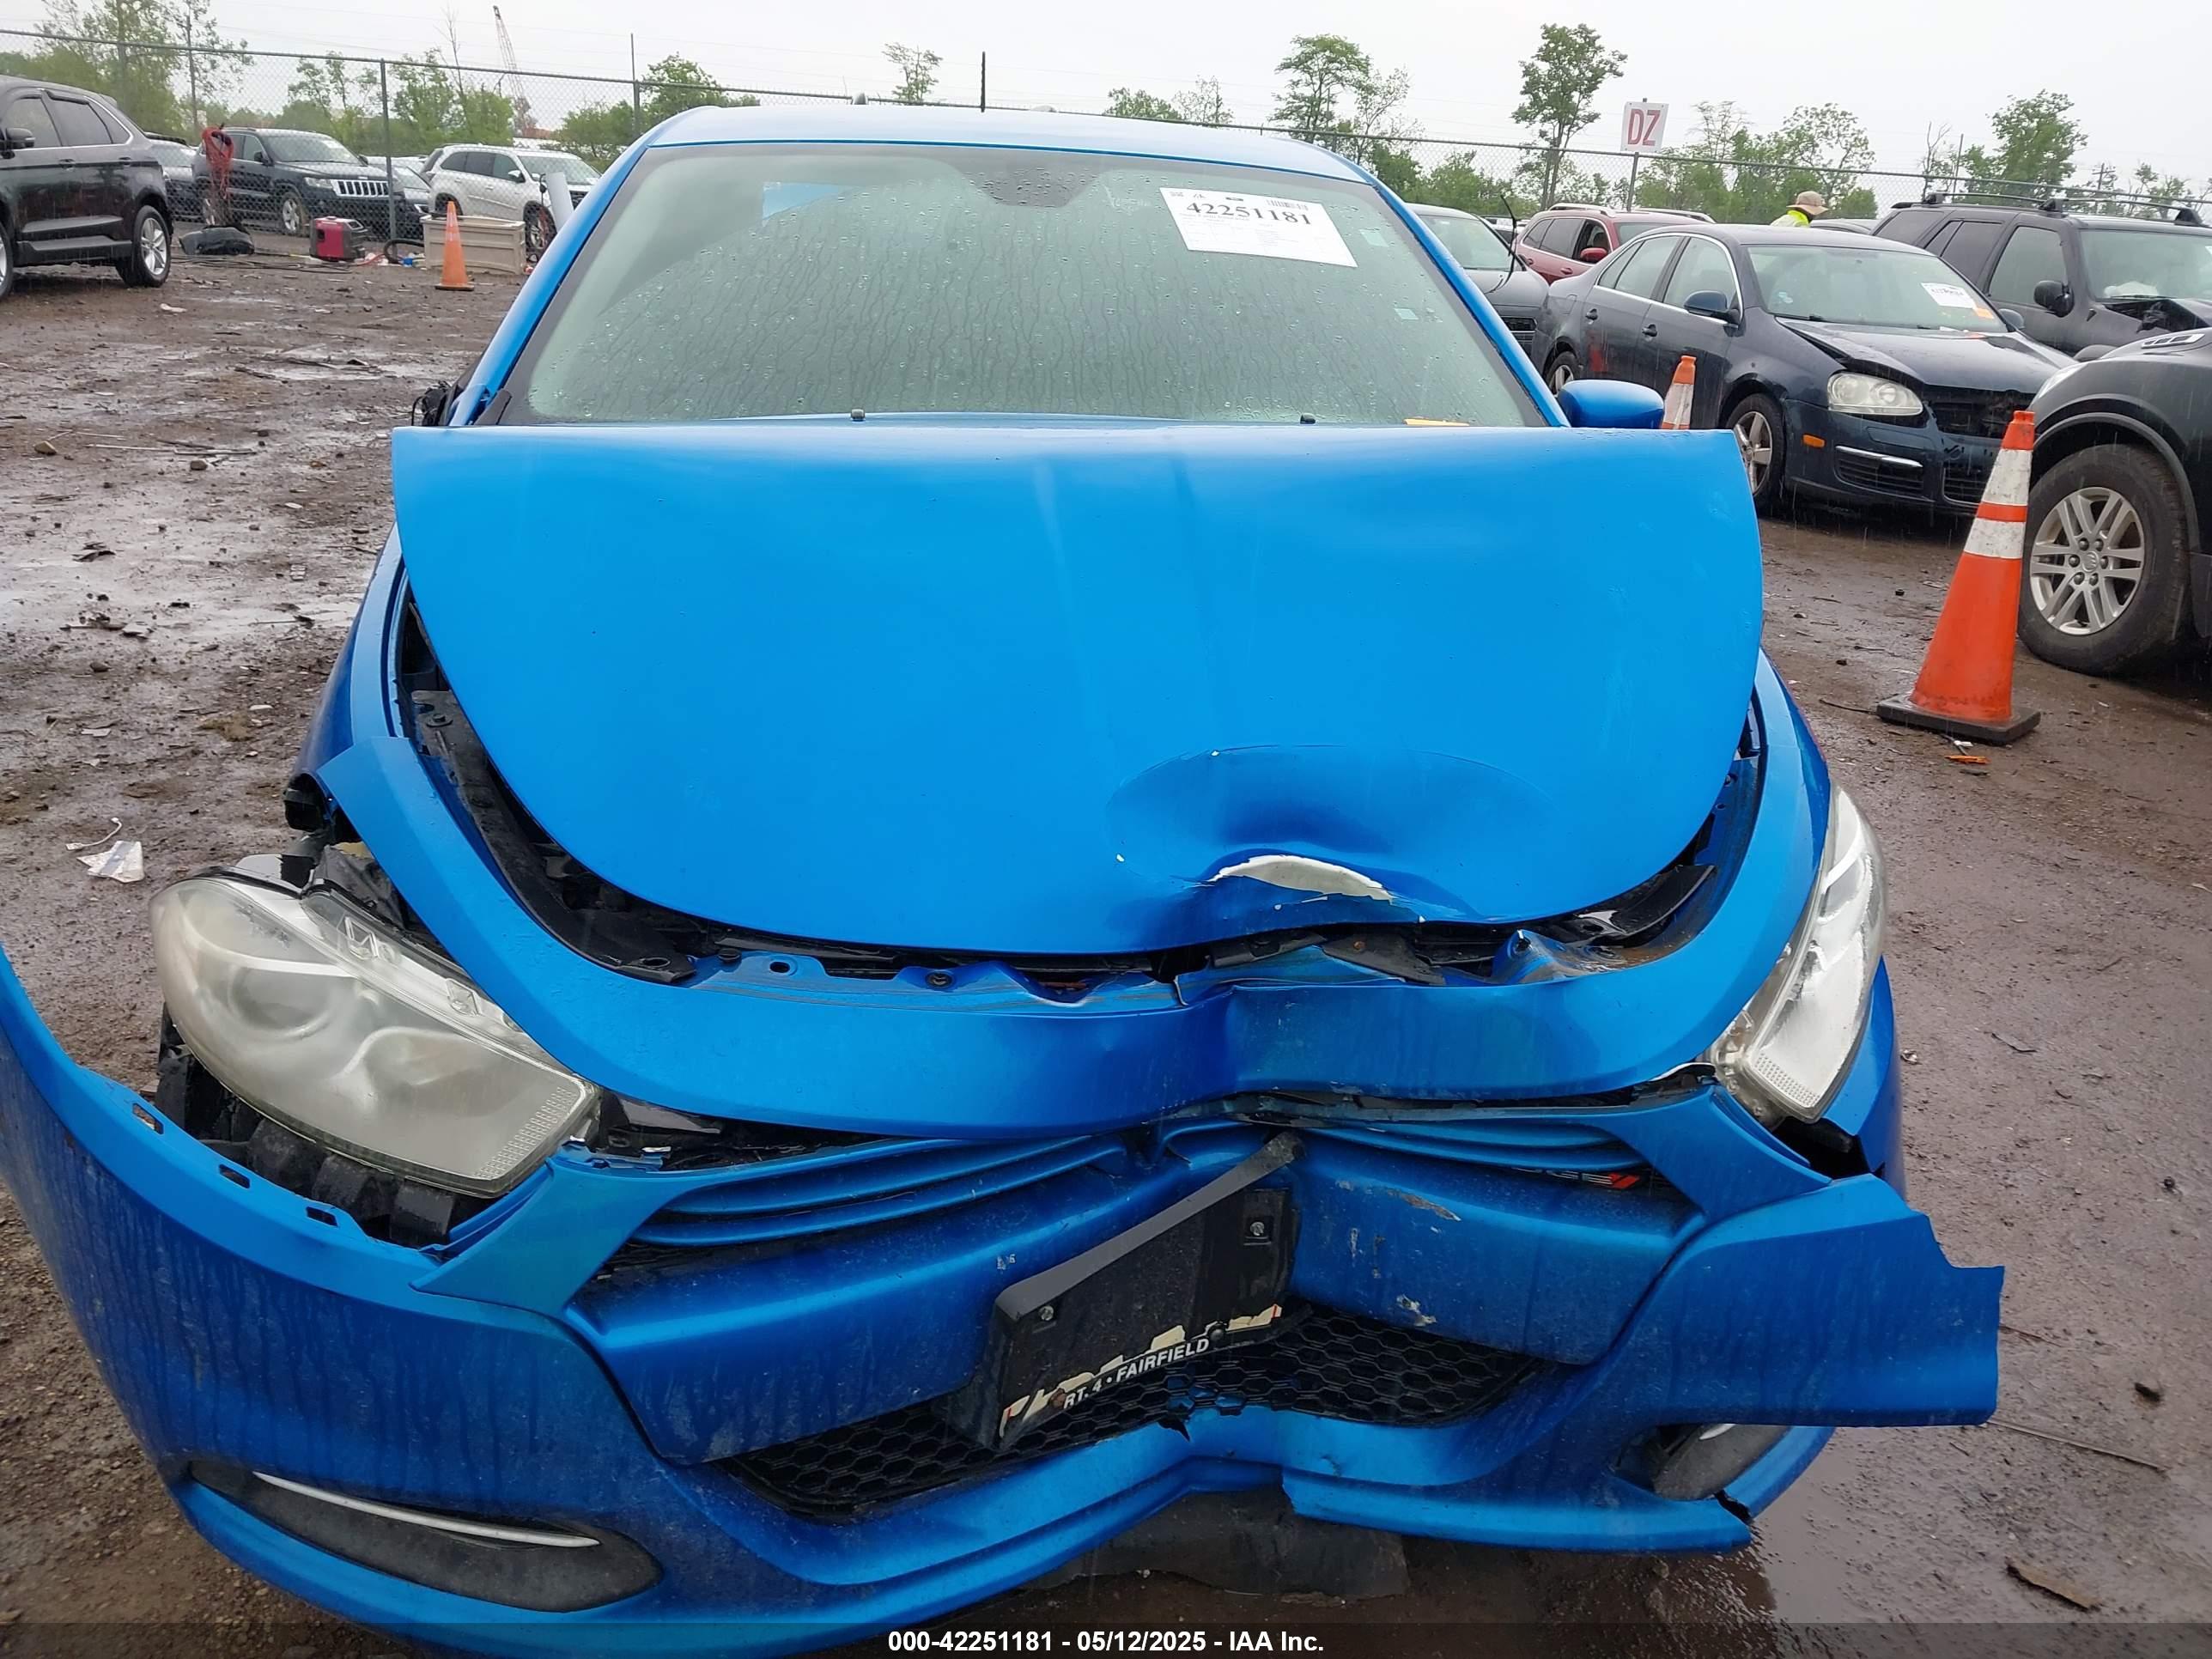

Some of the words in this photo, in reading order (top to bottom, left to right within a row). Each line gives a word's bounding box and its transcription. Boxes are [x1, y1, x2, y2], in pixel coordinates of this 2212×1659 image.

[1627, 108, 1661, 146] DZ
[1186, 201, 1312, 225] 42251181
[1063, 1386, 1089, 1409] RT.
[1091, 1377, 1103, 1392] 4
[1116, 1338, 1210, 1382] FAIRFIELD
